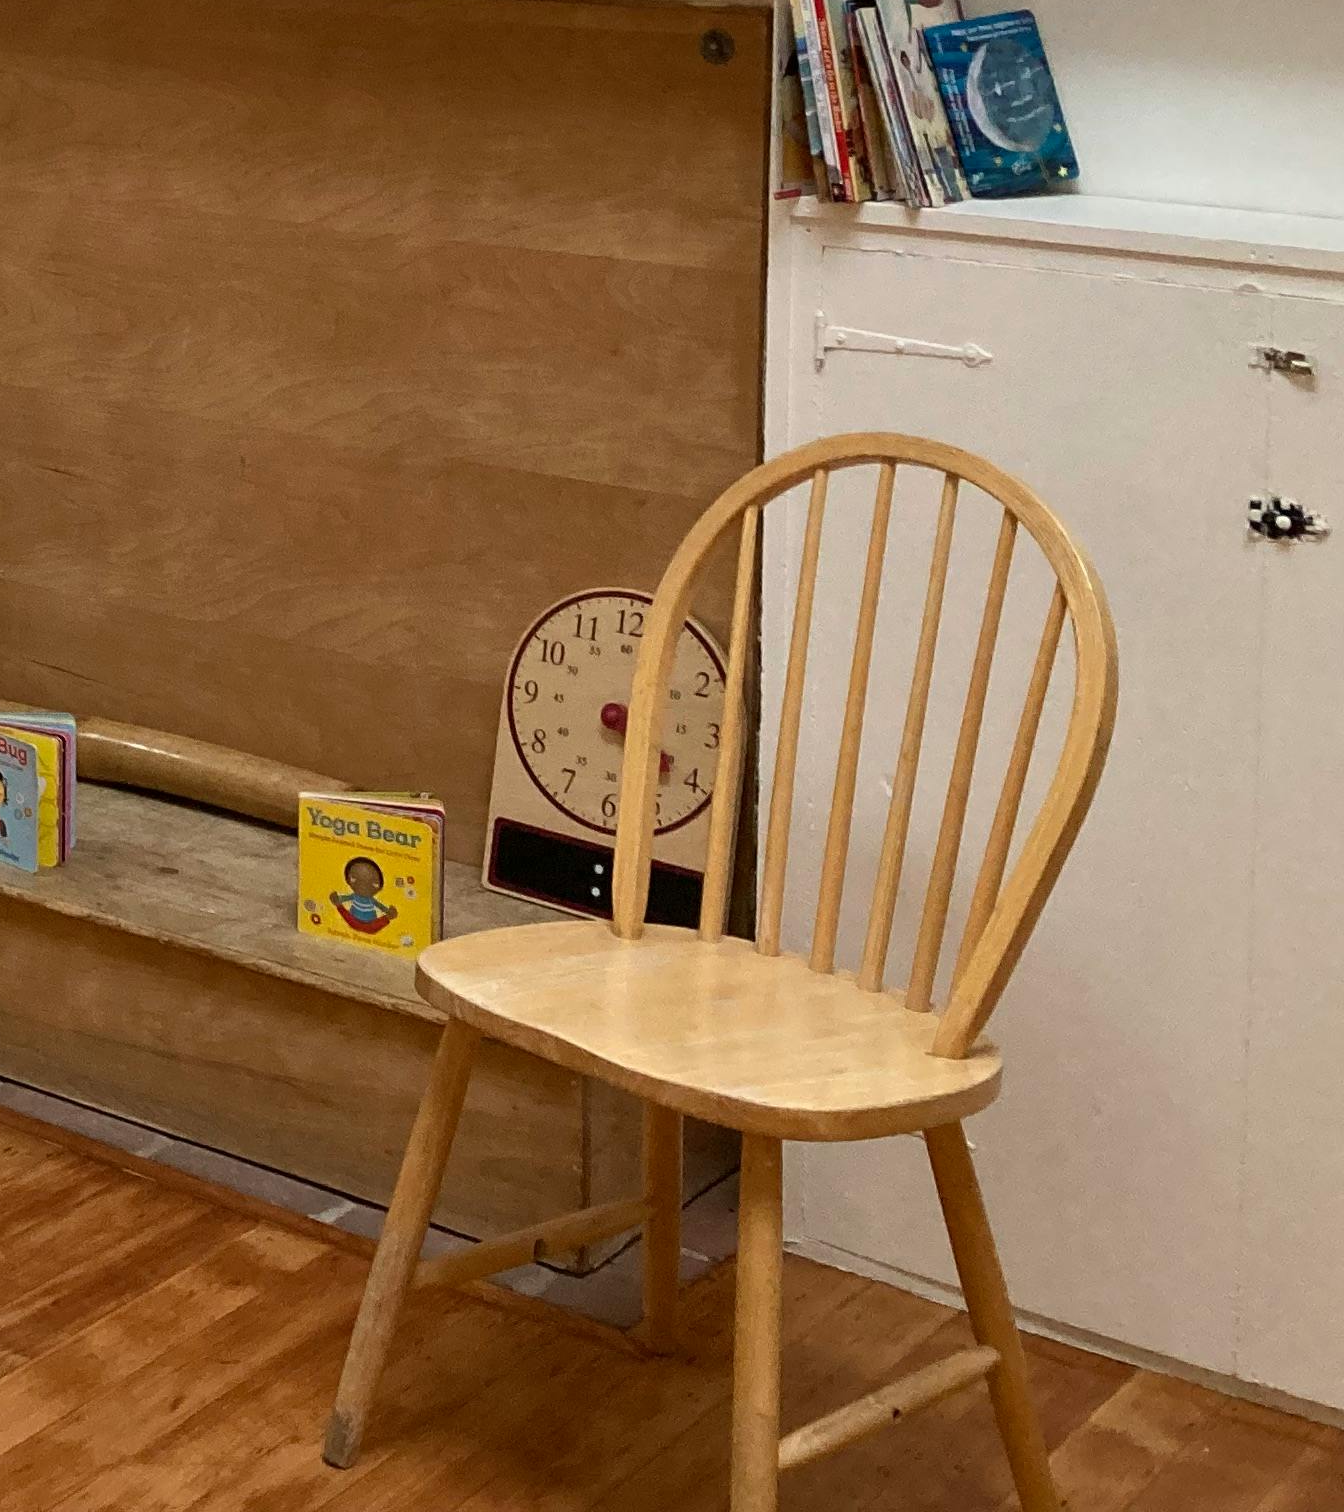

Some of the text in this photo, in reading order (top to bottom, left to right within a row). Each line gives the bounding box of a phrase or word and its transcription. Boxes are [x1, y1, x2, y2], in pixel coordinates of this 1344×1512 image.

[572, 613, 598, 641] 11
[616, 609, 645, 638] 12
[541, 639, 566, 666] 10
[523, 680, 539, 704] 9
[694, 671, 710, 698] 2
[531, 729, 546, 754] 8
[704, 722, 720, 750] 3
[562, 767, 577, 794] 7
[683, 768, 701, 794] 4
[601, 793, 618, 818] 6
[306, 806, 360, 837] Yoga
[366, 820, 422, 849] Bear
